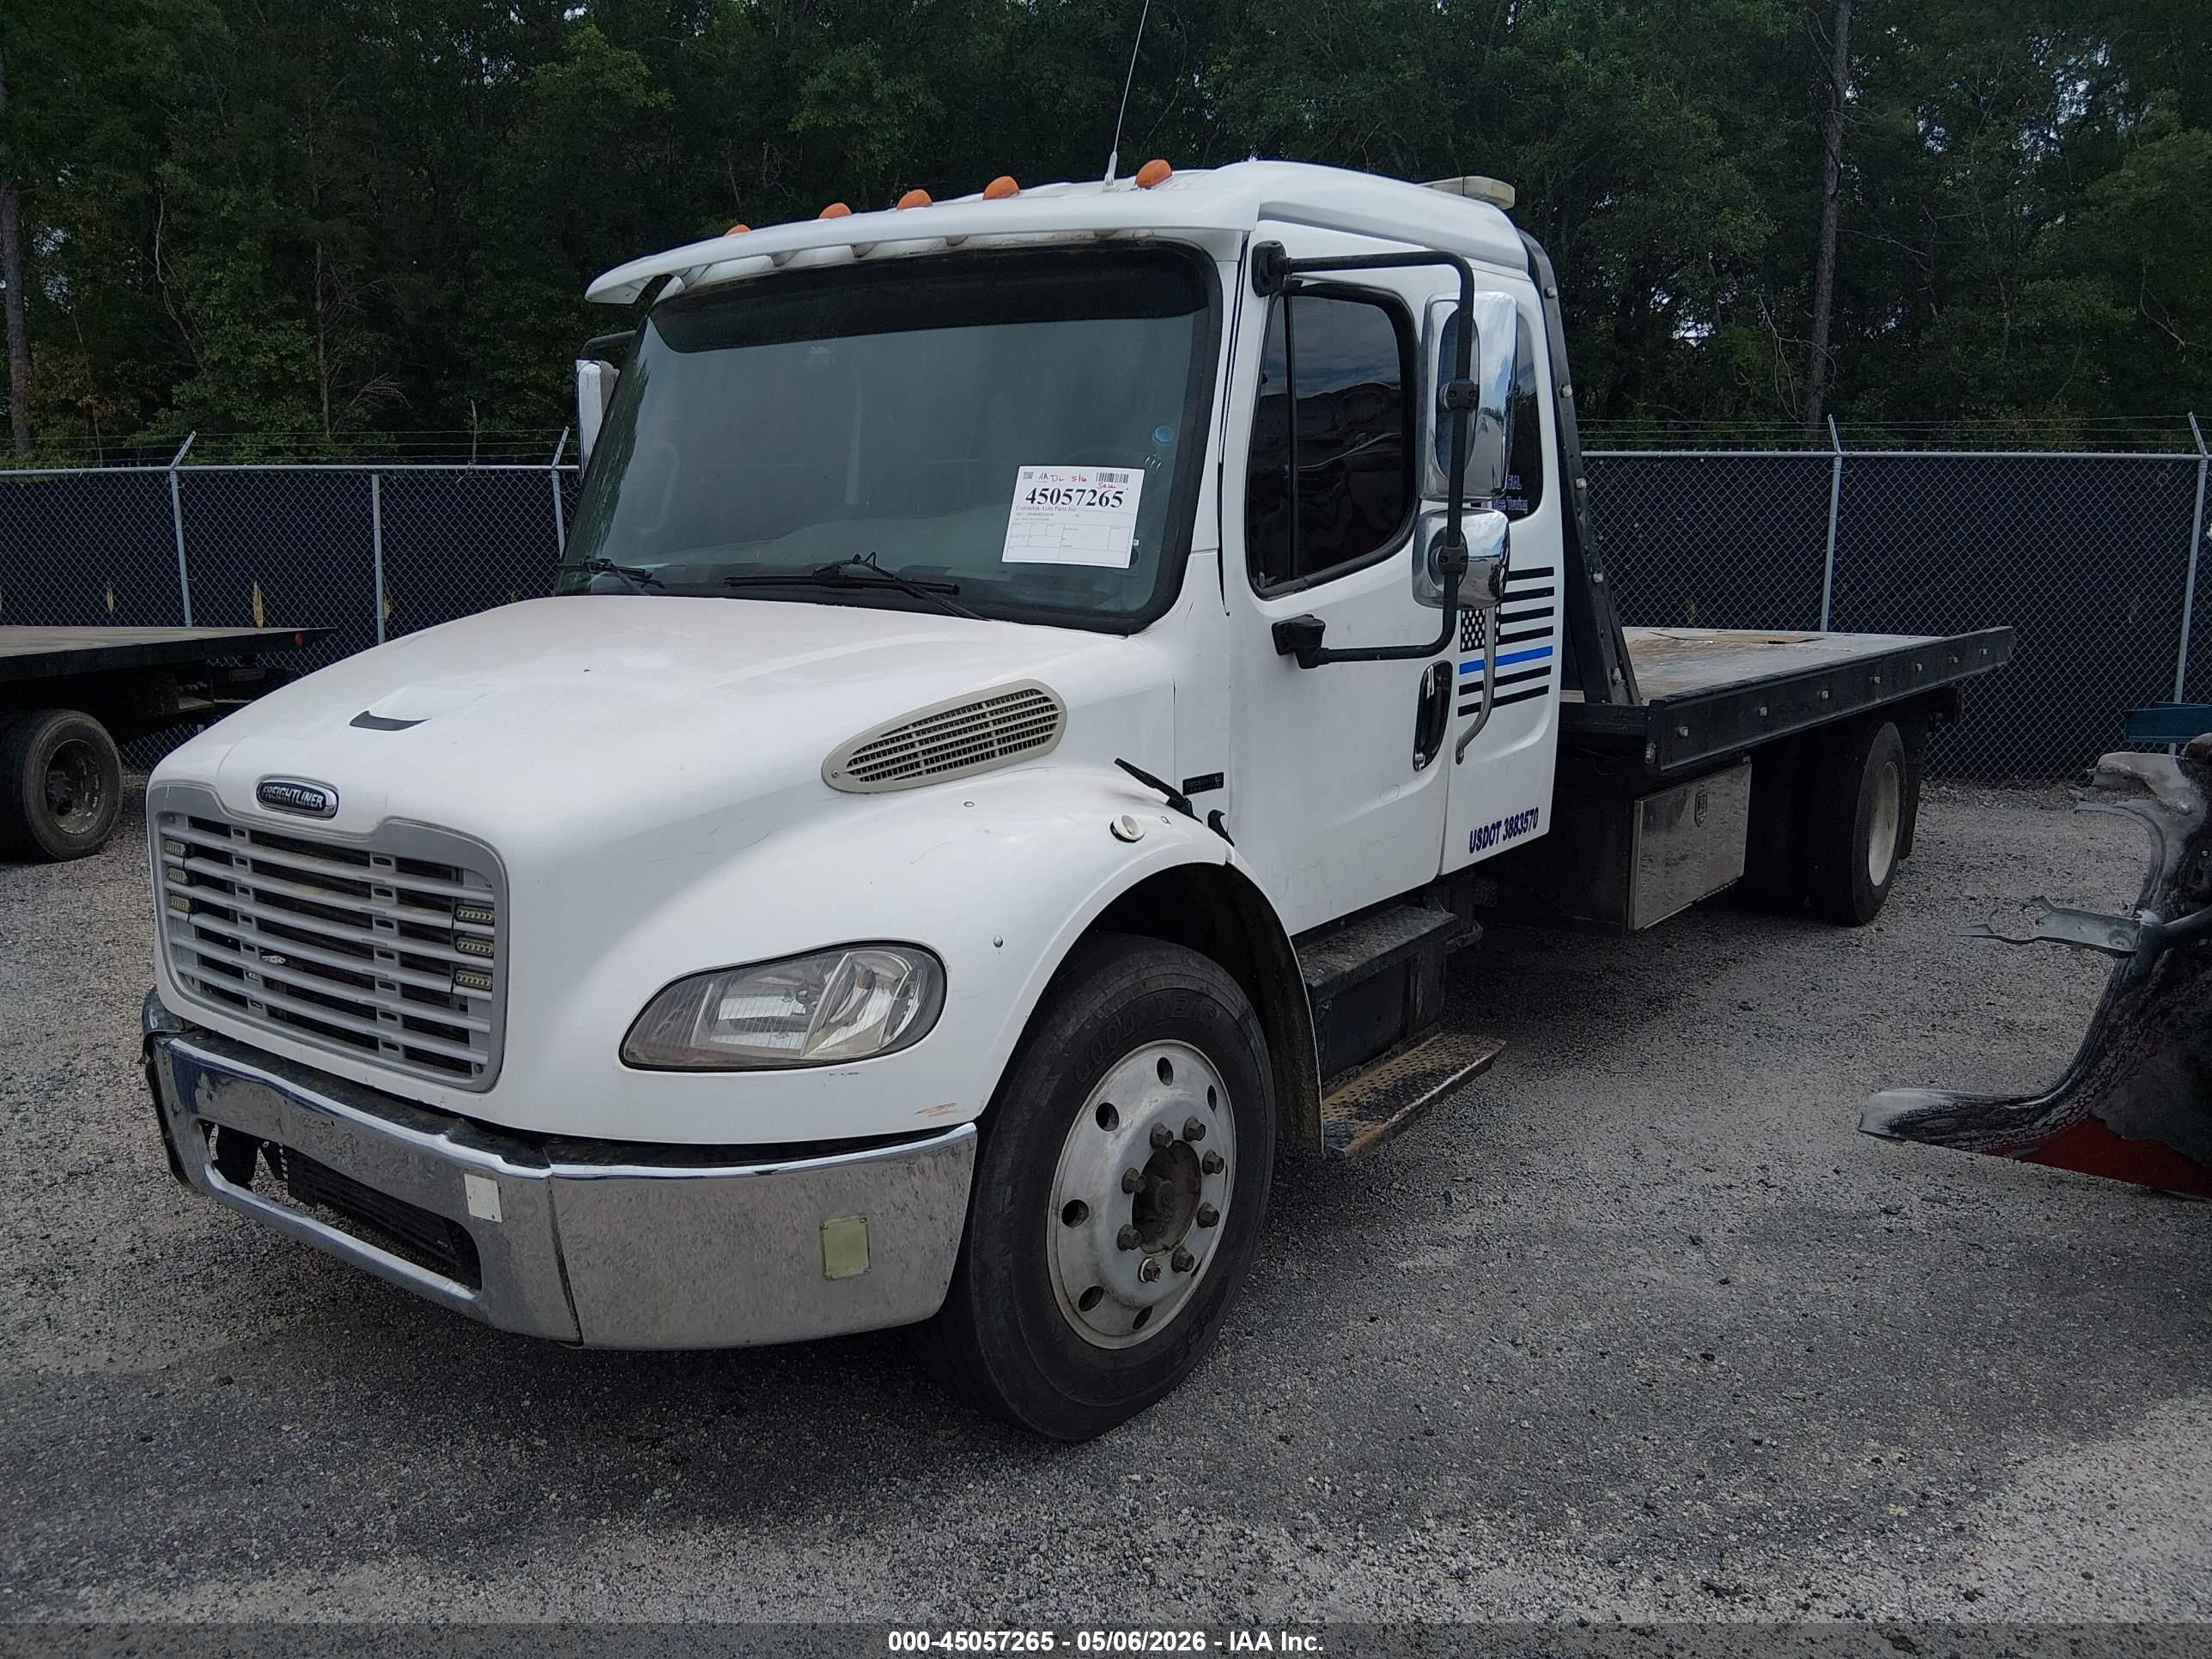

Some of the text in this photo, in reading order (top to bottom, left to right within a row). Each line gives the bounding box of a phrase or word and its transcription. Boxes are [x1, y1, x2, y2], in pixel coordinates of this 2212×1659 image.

[1025, 487, 1124, 508] 45057265
[1469, 806, 1539, 854] USDOT 3883570
